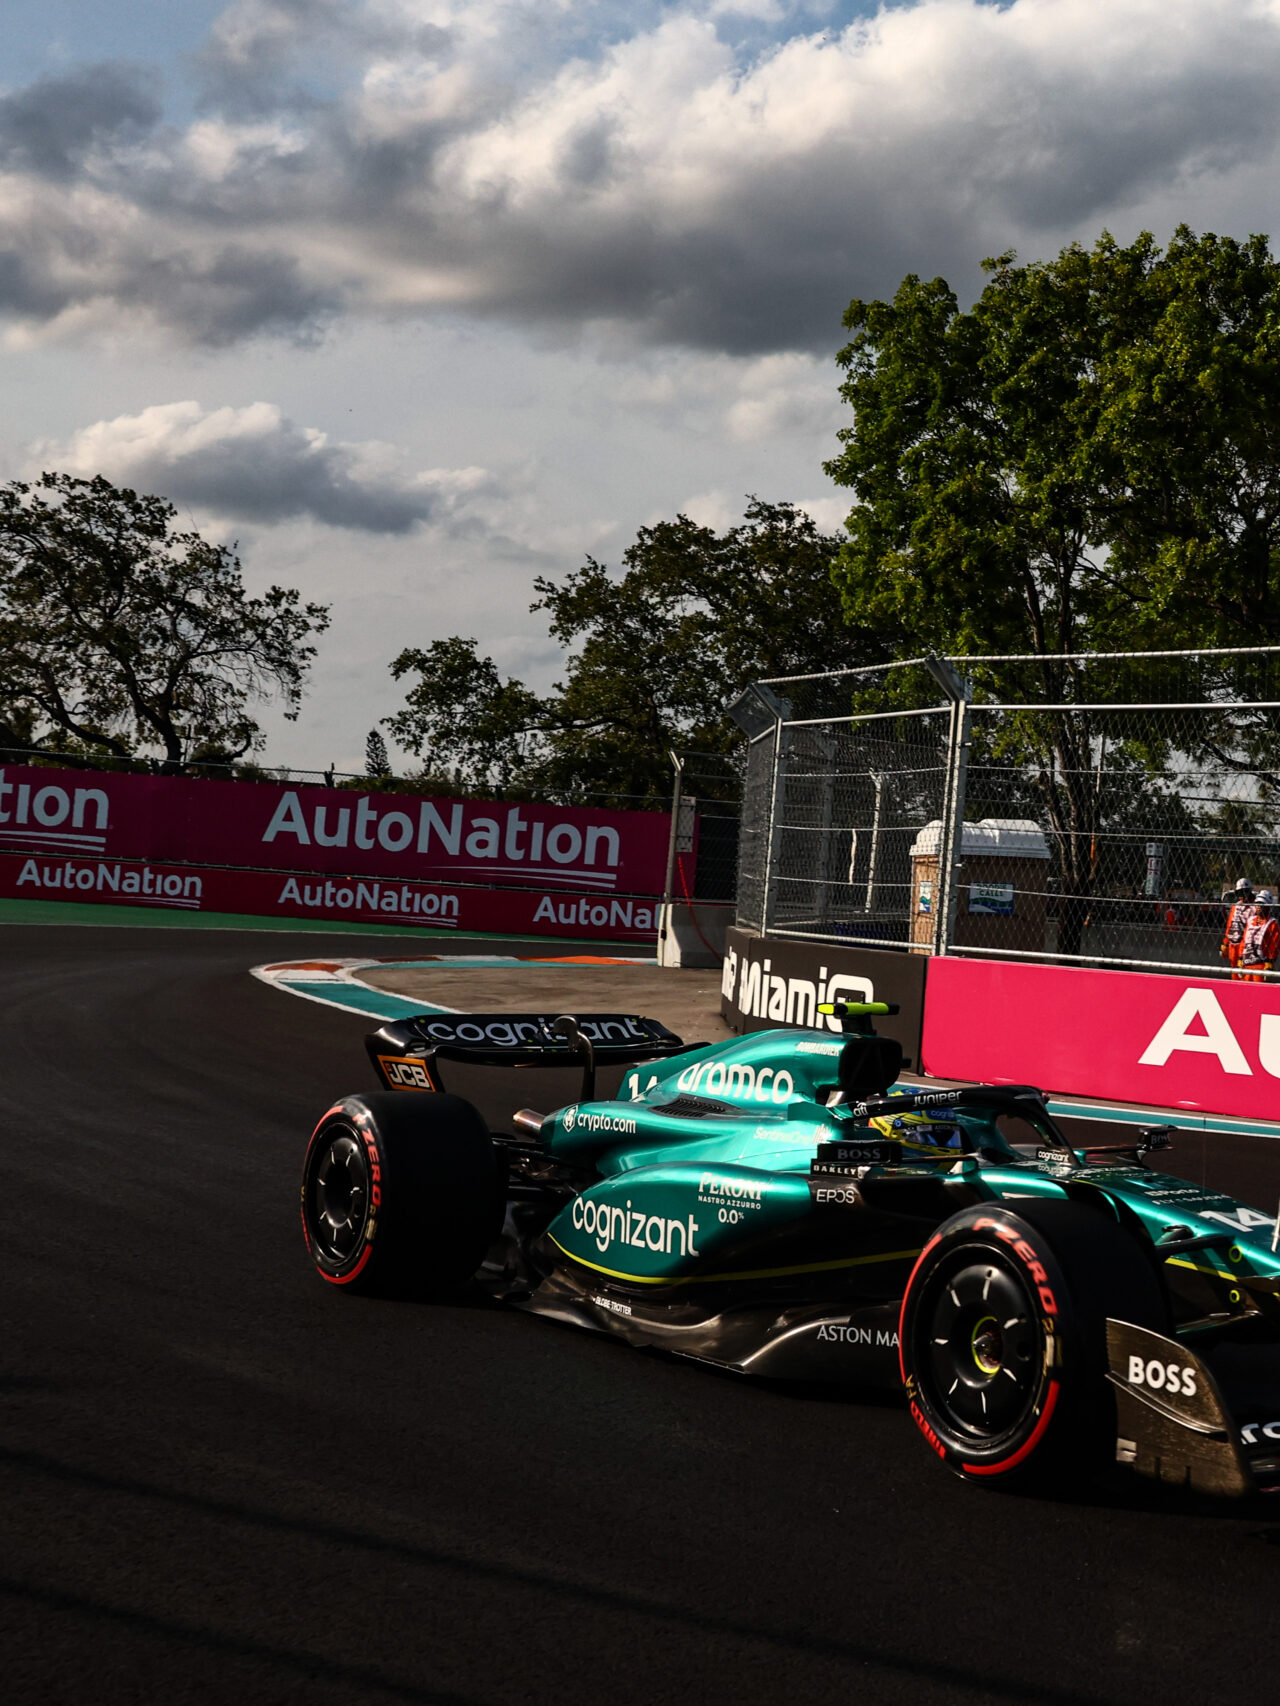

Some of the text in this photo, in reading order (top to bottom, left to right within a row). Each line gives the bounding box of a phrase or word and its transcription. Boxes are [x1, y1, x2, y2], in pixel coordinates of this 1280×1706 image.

[262, 791, 621, 866] AutoNation
[16, 859, 202, 897] AutoNation
[278, 878, 460, 917] AutoNation
[389, 1063, 430, 1088] JCB
[678, 1062, 793, 1104] aramco
[577, 1113, 636, 1134] crypto.com
[361, 1127, 381, 1206] ZERO
[837, 1148, 881, 1160] BOSS
[1037, 1150, 1069, 1163] cognizant
[813, 1164, 856, 1175] OAKLEY
[698, 1196, 761, 1210] NASTRO AZZURRO
[816, 1188, 855, 1203] EPOS
[572, 1196, 699, 1257] cognizant
[1197, 1208, 1277, 1233] 14
[994, 1222, 1059, 1315] ZERO
[817, 1325, 872, 1344] ASTON
[1128, 1355, 1198, 1396] BOSS
